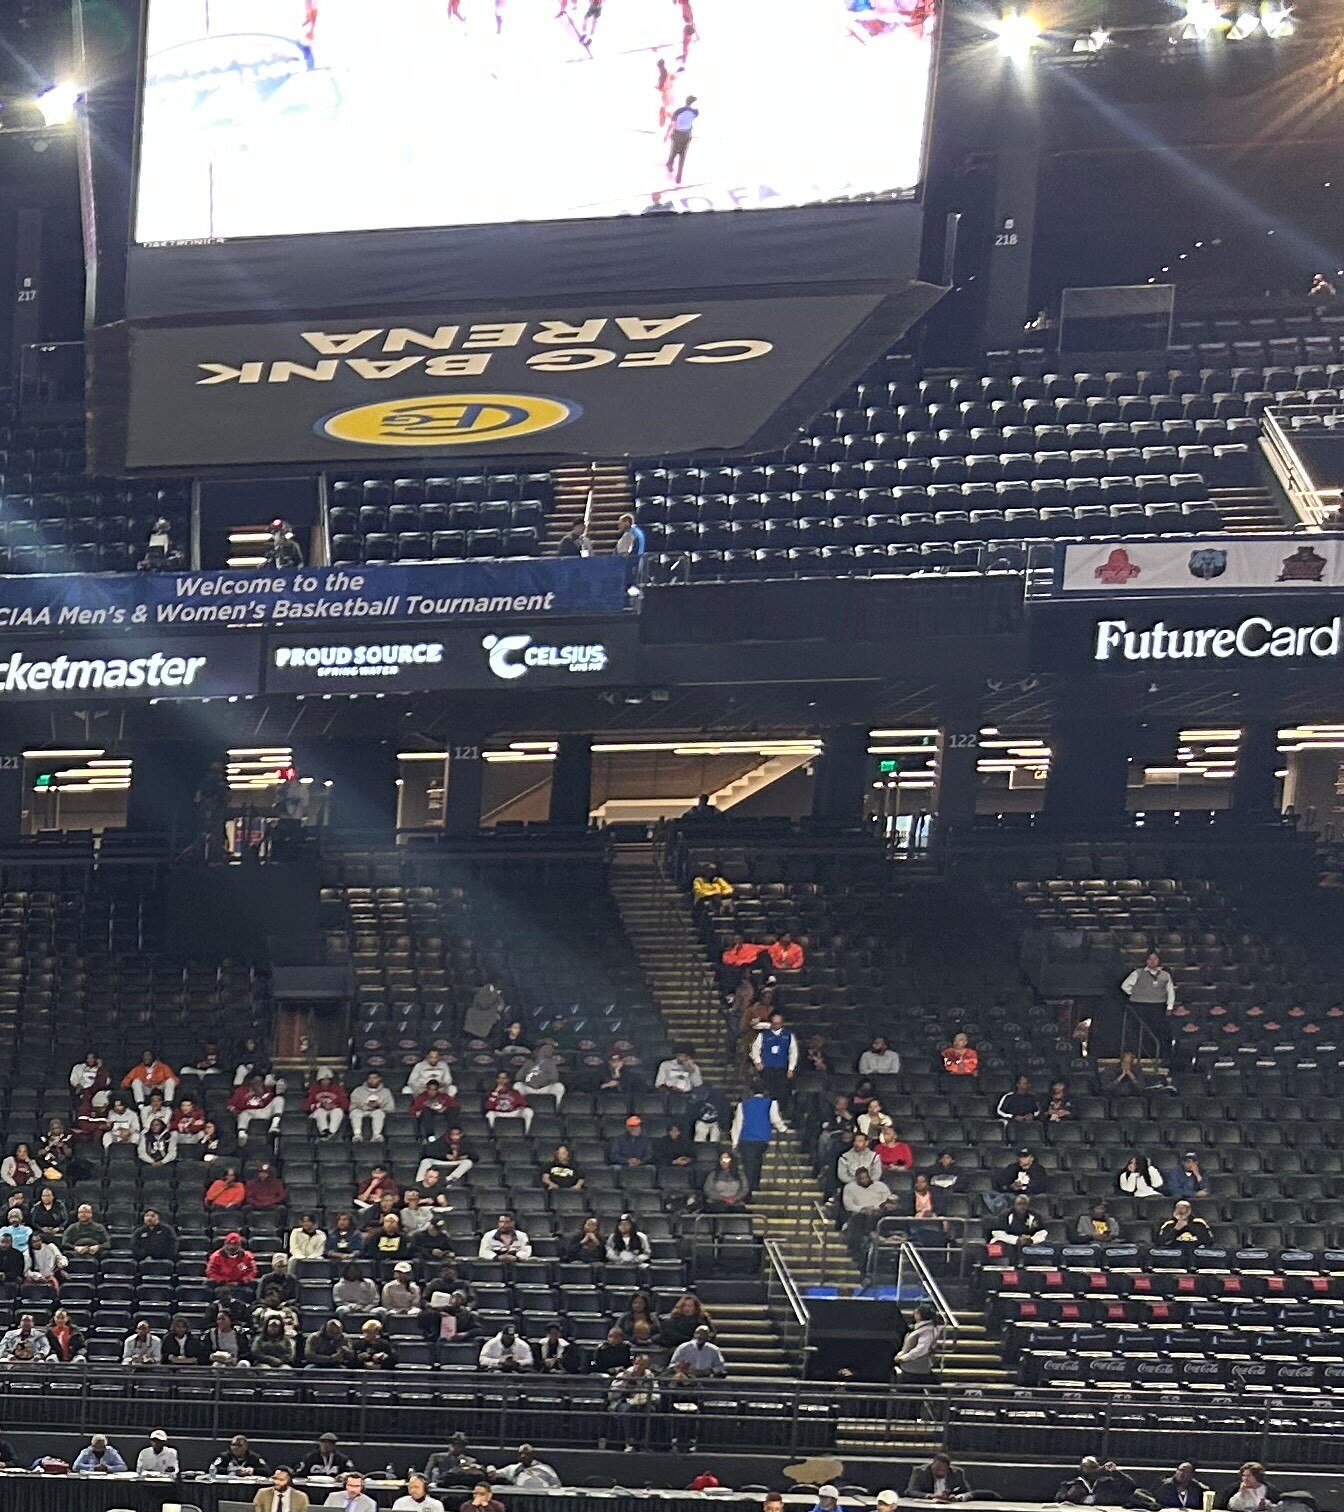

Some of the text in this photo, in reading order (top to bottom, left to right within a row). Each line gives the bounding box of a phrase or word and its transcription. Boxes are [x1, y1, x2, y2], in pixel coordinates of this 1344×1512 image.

[994, 233, 1018, 246] 218
[17, 289, 37, 302] 217
[300, 312, 704, 355] ARENA
[197, 338, 775, 386] CFG BANK
[174, 571, 366, 598] Welcome to the
[57, 603, 125, 626] Men's
[130, 603, 149, 624] &
[156, 601, 266, 624] Women's
[272, 595, 400, 621] Basketball
[405, 590, 554, 617] Tournament
[1094, 616, 1343, 661] FutureCard
[275, 643, 444, 667] PROUD SOURCE
[453, 745, 479, 760] 121
[949, 733, 977, 749] 122
